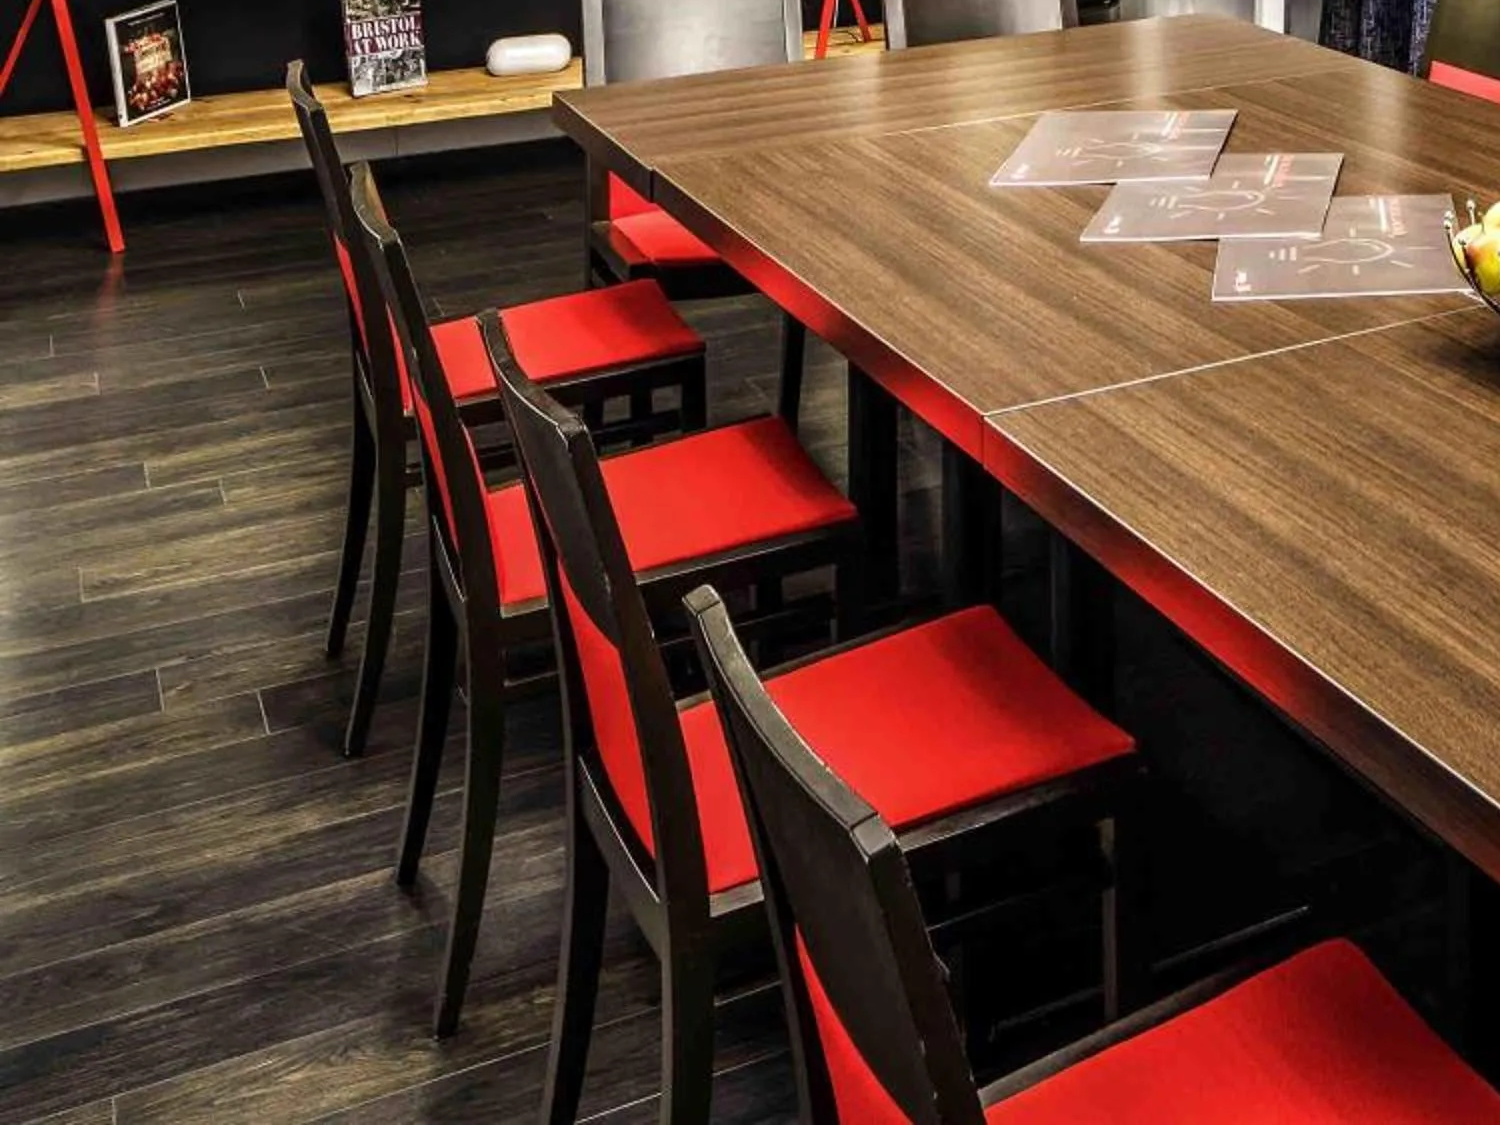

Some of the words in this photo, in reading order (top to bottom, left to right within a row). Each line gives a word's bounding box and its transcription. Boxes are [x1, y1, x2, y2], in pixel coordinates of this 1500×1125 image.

[352, 16, 421, 39] BRISTOL
[352, 37, 372, 55] AT
[375, 30, 421, 50] WORK
